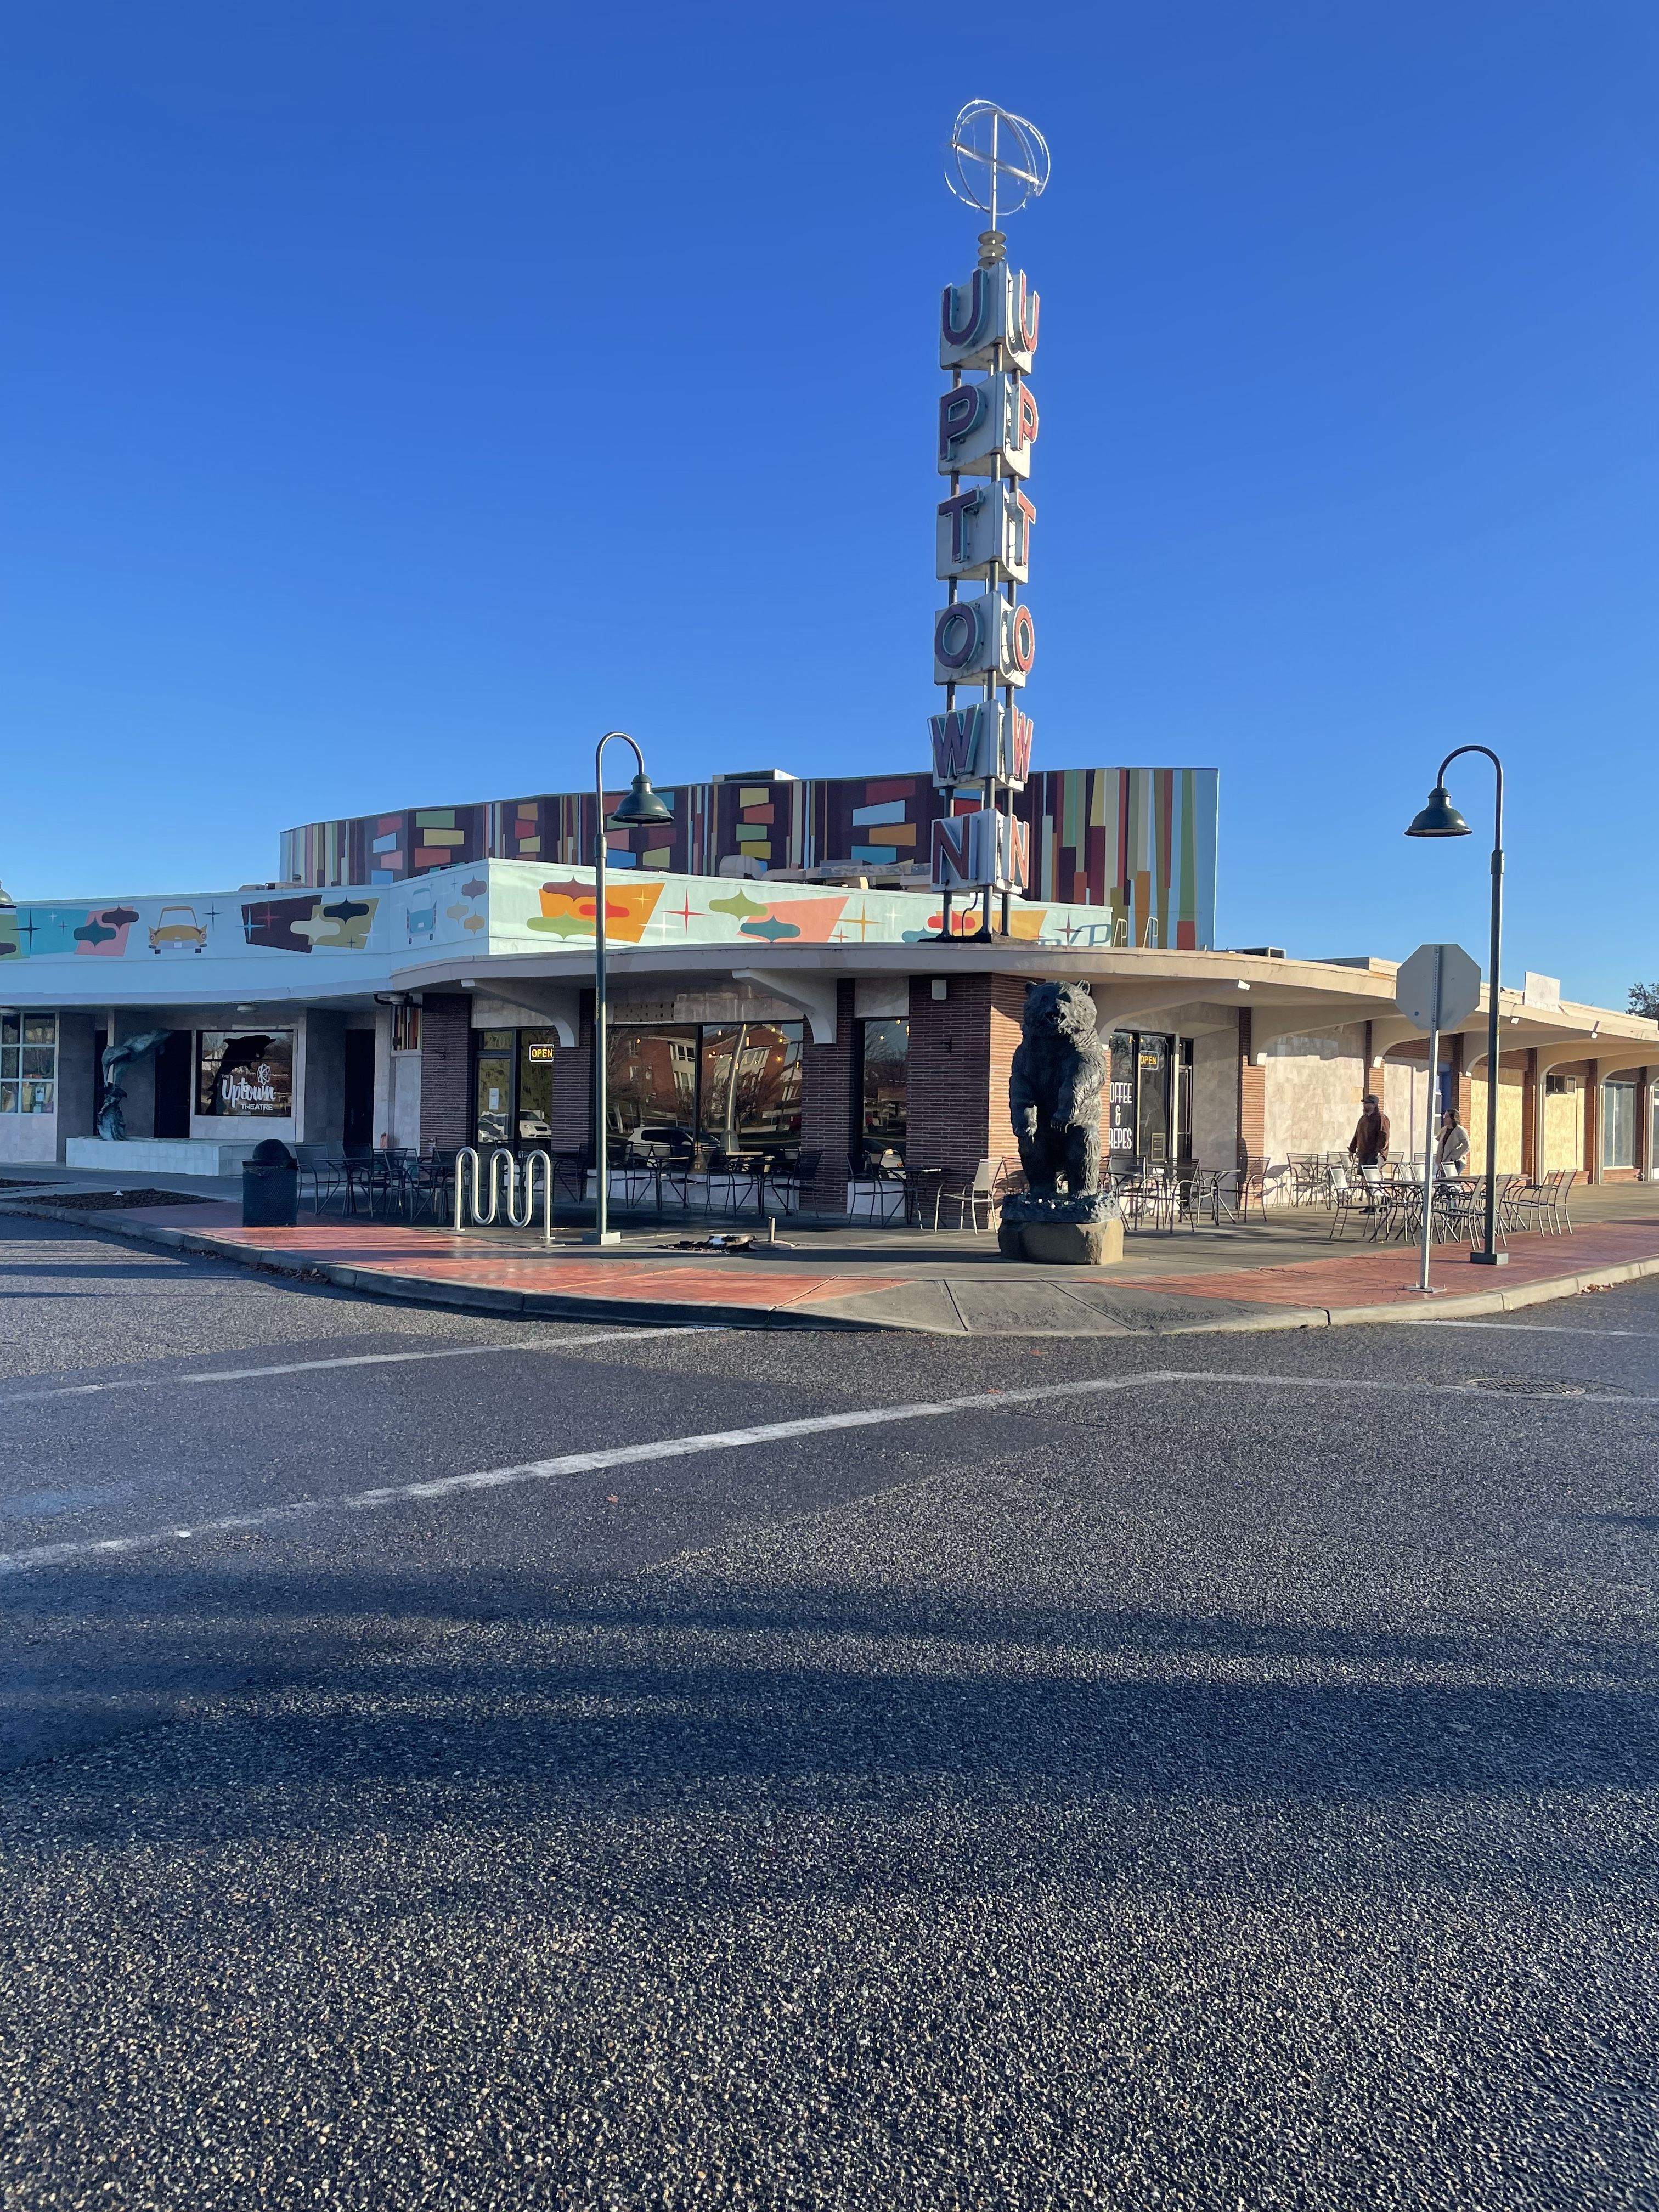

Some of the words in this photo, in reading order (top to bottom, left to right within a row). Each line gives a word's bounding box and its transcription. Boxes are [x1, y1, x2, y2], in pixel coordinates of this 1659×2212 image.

[927, 267, 985, 885] UPTOWN
[1007, 269, 1040, 889] UPTOWN
[488, 1035, 505, 1047] 270
[532, 1049, 552, 1058] OPEN
[1140, 1056, 1157, 1065] OPEN
[222, 1075, 276, 1108] Uptown
[1110, 1082, 1132, 1103] OFFEE
[1115, 1105, 1121, 1126] &
[1109, 1127, 1132, 1149] REPES
